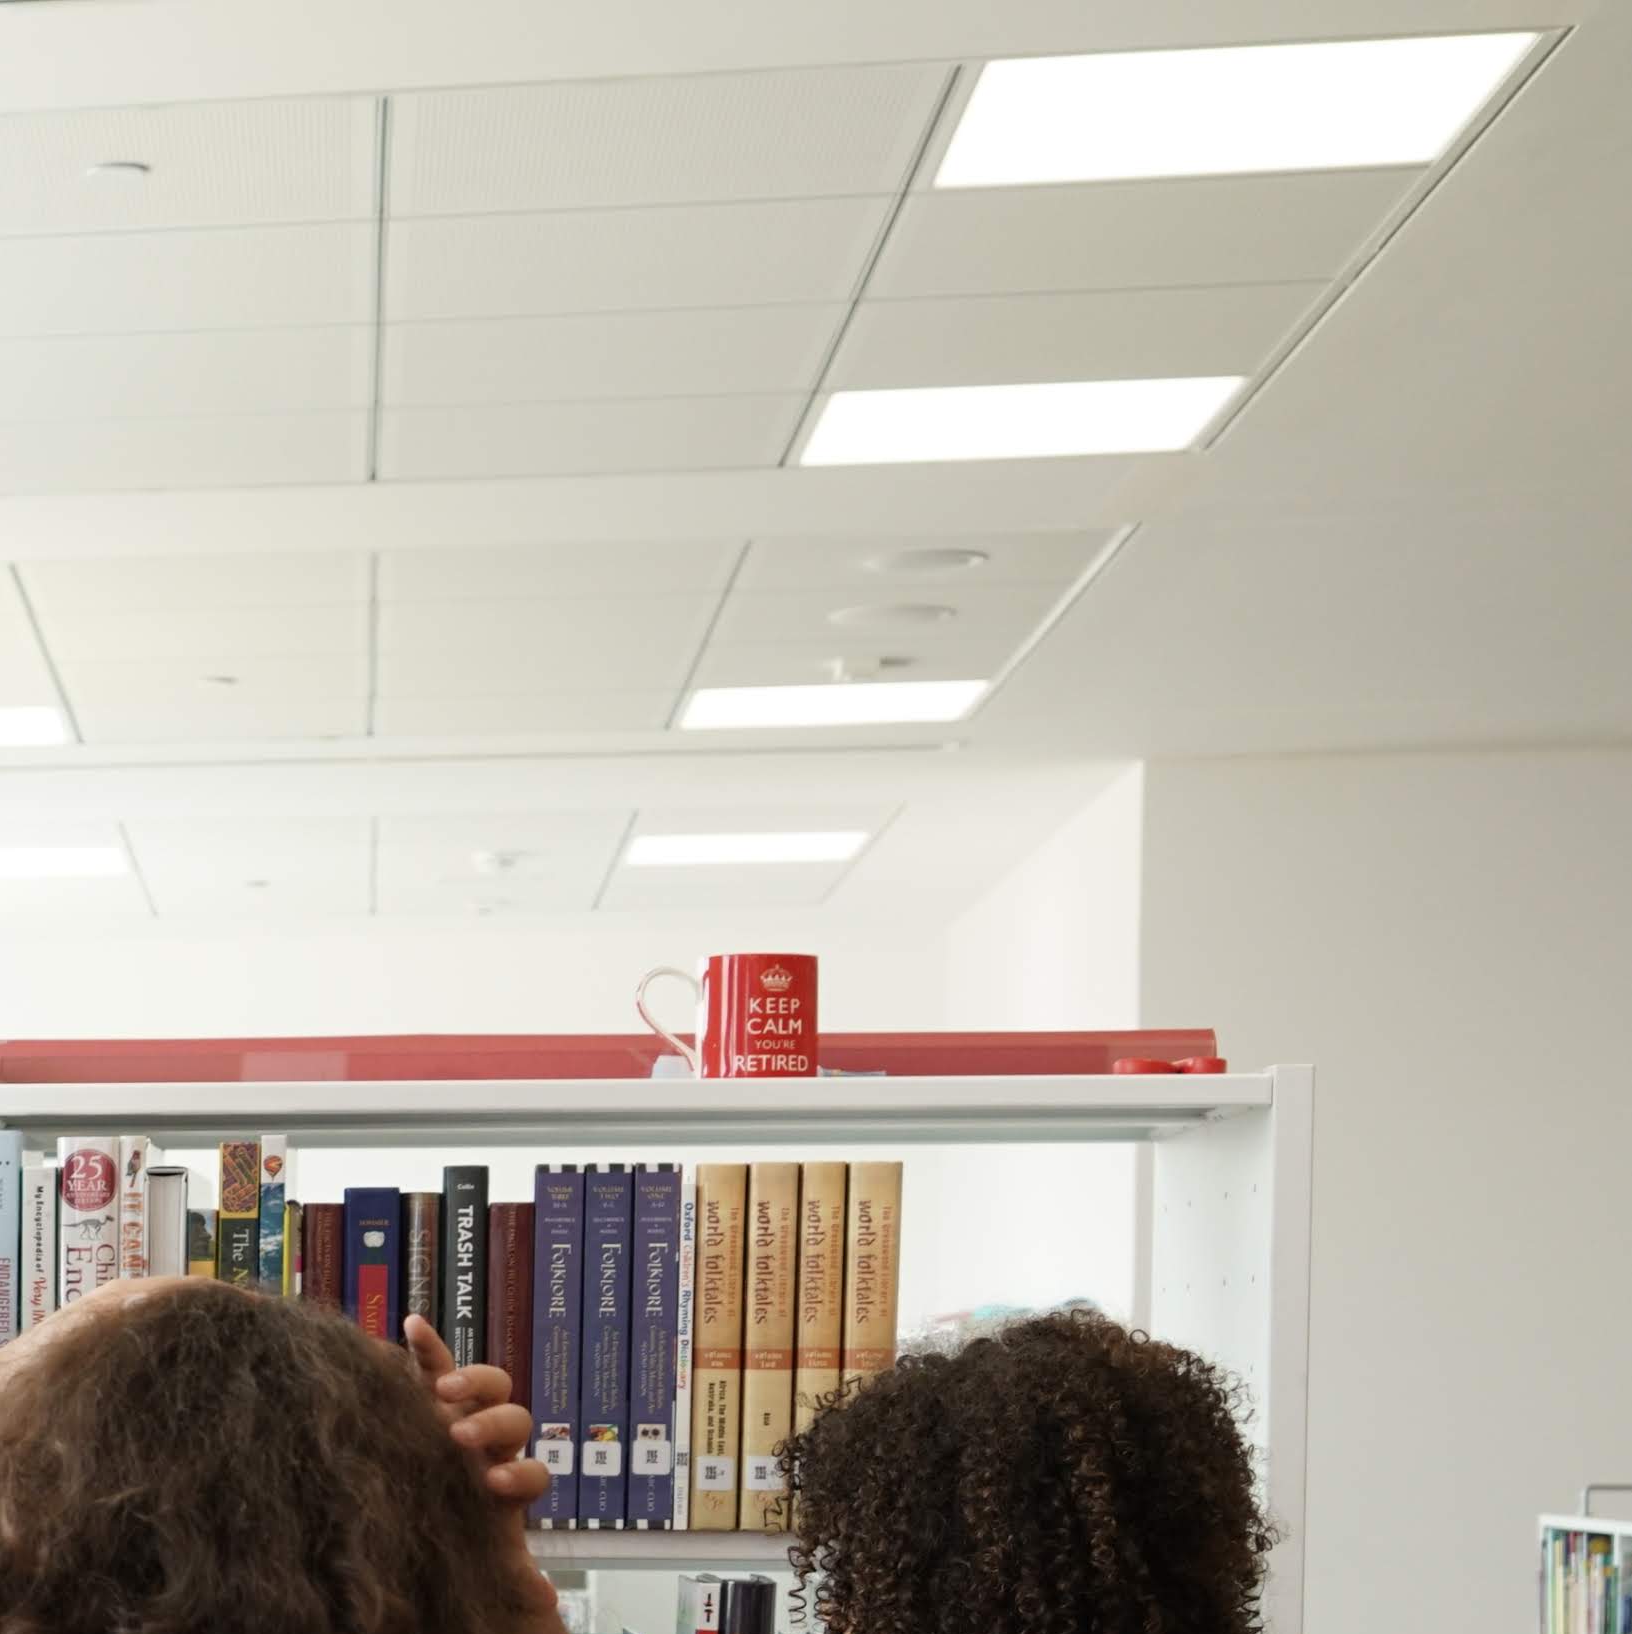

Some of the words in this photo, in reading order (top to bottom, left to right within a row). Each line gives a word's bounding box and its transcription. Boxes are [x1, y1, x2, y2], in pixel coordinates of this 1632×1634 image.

[747, 1018, 802, 1034] CALM
[749, 998, 800, 1014] KEEP
[735, 1055, 808, 1072] RETIRED
[755, 1040, 795, 1049] YOU'RE
[67, 1180, 107, 1192] YEAR
[70, 1155, 103, 1180] 25
[34, 1186, 44, 1199] My
[33, 1201, 44, 1262] Encyclopedia
[457, 1205, 474, 1267] TRASH
[683, 1202, 693, 1241] Oxford
[705, 1201, 724, 1247] world
[756, 1201, 775, 1247] world
[806, 1201, 826, 1247] world
[857, 1201, 876, 1247] world
[36, 1263, 44, 1273] of
[232, 1229, 249, 1262] The
[682, 1244, 691, 1287] Children's
[31, 1277, 47, 1305] Very
[408, 1228, 431, 1313] SIGNS
[549, 1242, 572, 1318] FOLKLORE
[598, 1242, 622, 1318] FOLKLORE
[645, 1242, 669, 1318] FOLKLORE
[704, 1255, 724, 1325] folktales
[754, 1255, 775, 1325] folktales
[805, 1255, 825, 1325] folktales
[855, 1255, 876, 1325] folktales
[32, 1310, 46, 1327] IM
[456, 1272, 473, 1319] TALK
[679, 1290, 691, 1336] Rhyming
[467, 1327, 474, 1336] AN
[678, 1339, 689, 1389] Dictionary
